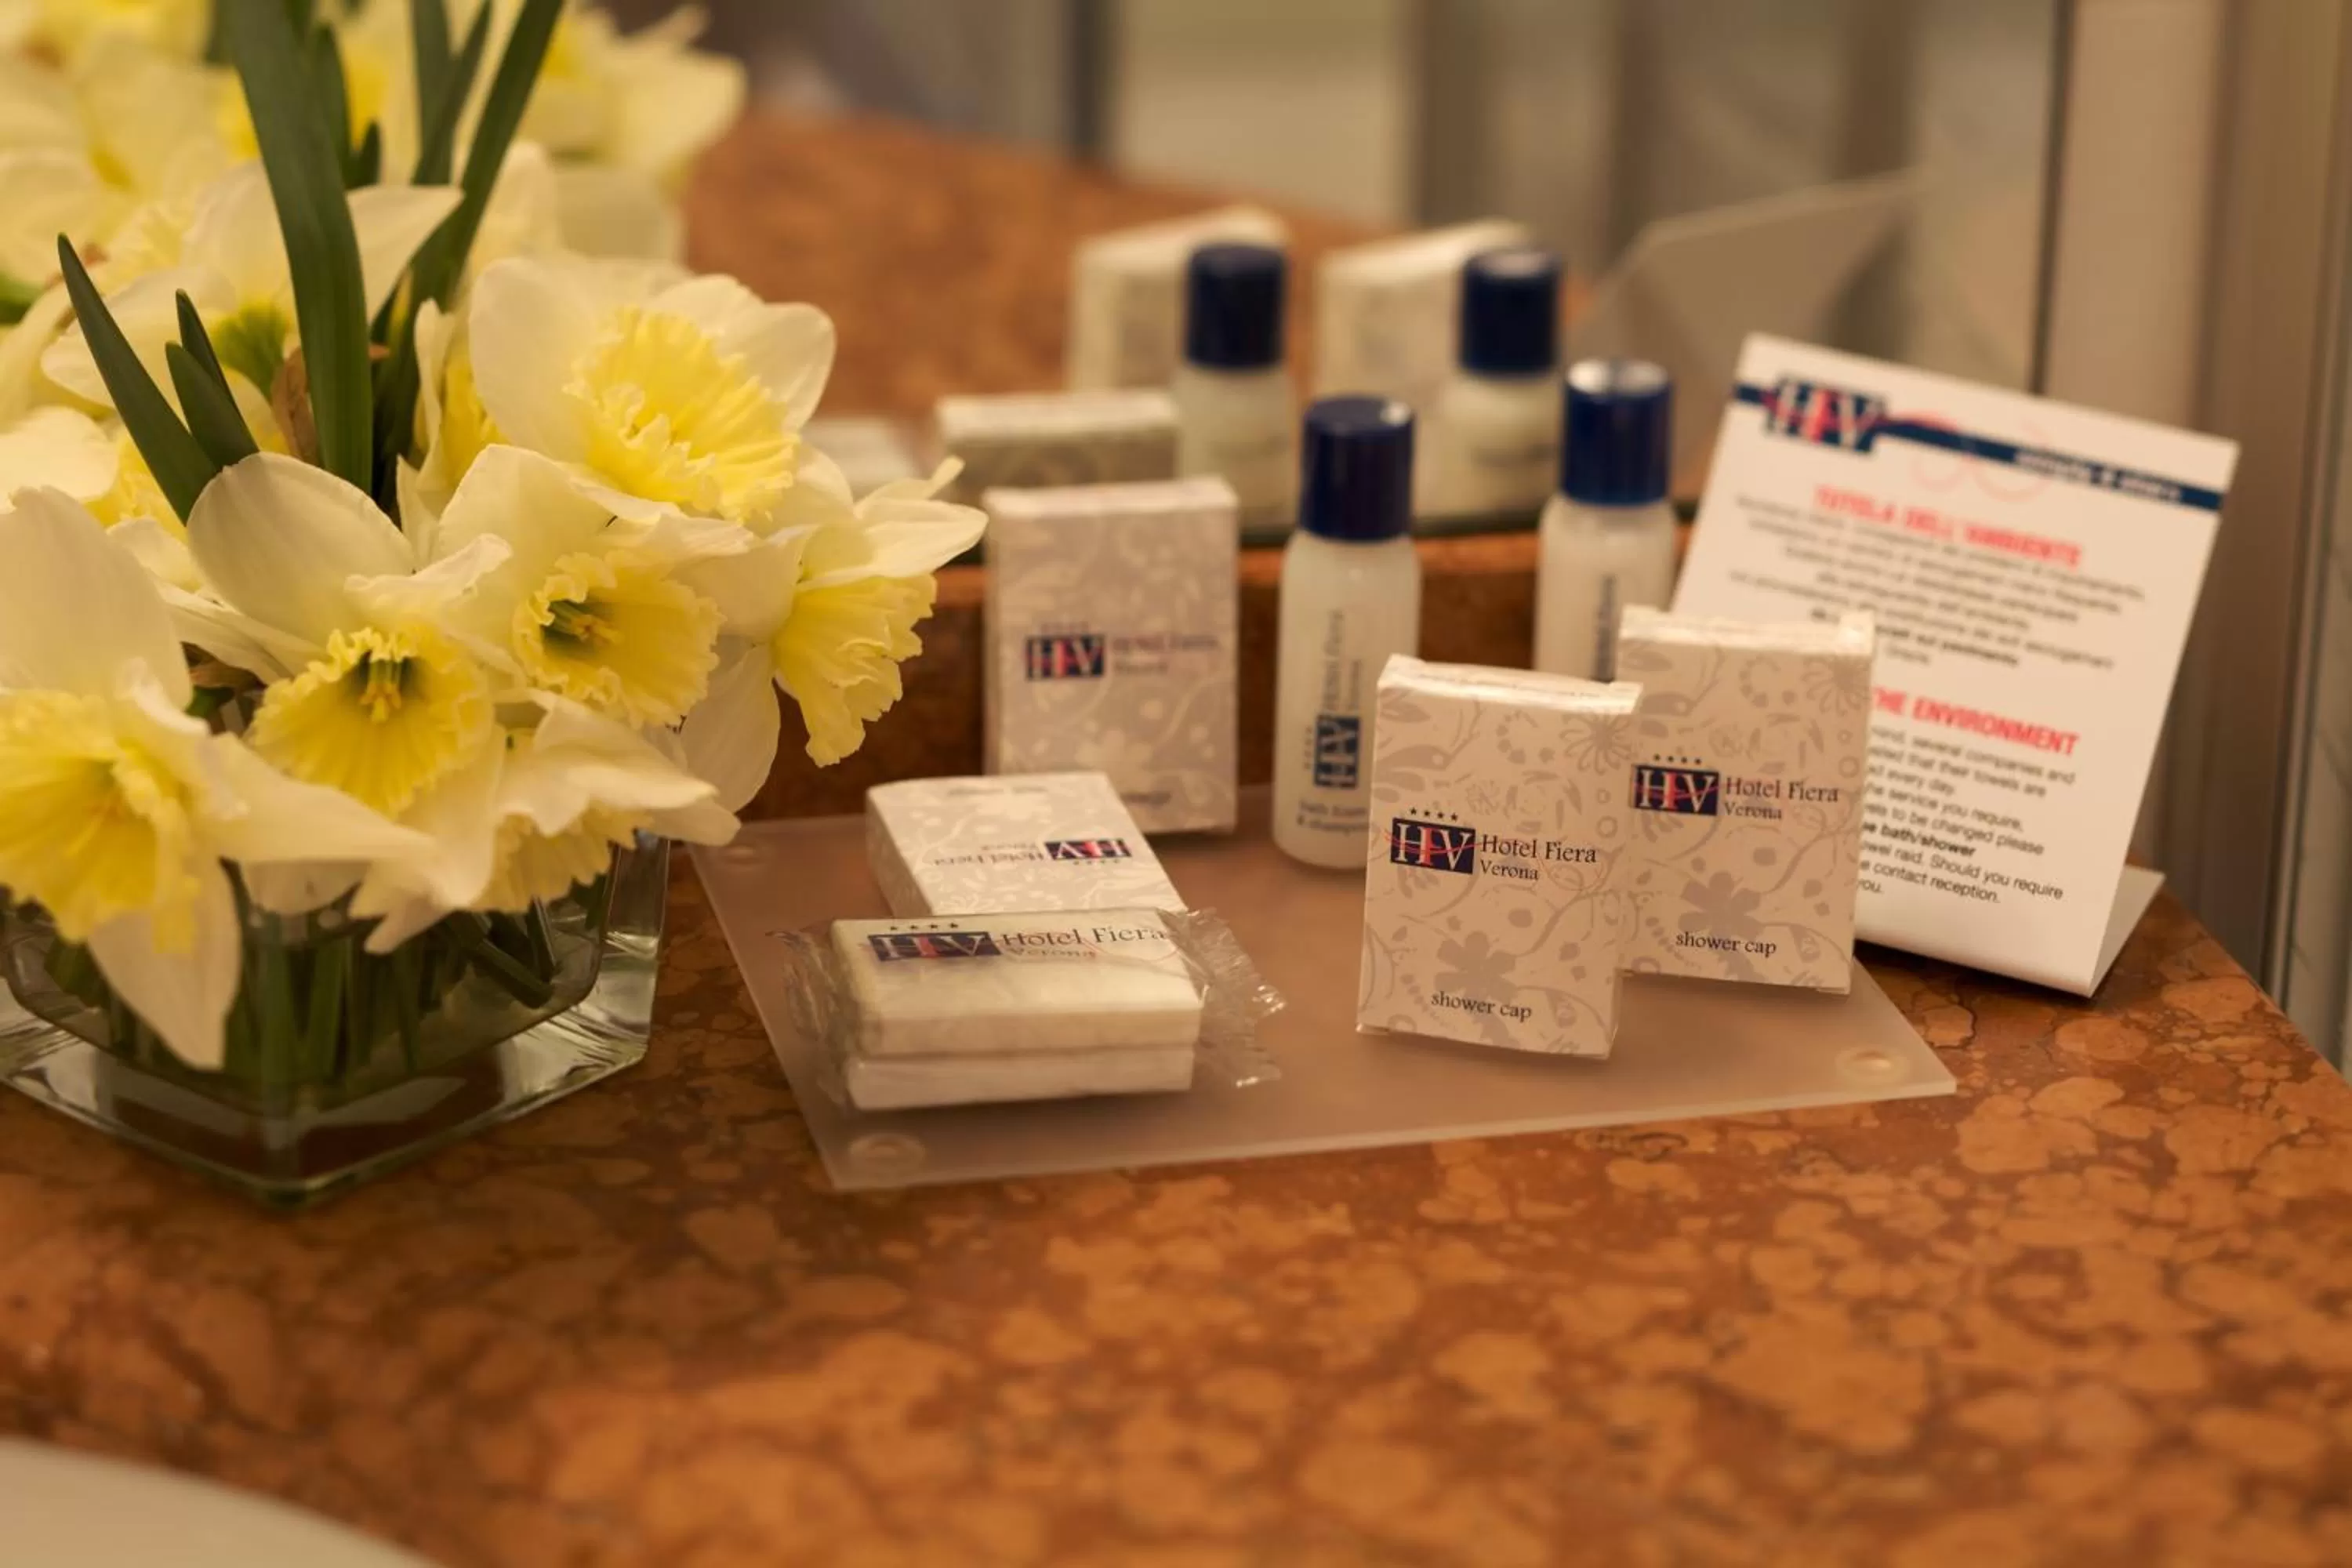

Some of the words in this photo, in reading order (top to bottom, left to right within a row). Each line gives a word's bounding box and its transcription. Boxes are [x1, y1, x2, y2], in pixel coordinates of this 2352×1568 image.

[1912, 697, 2080, 755] ENVIRONMENT
[1725, 777, 1780, 800] Hotel
[1788, 780, 1839, 803] Fiera
[1724, 801, 1782, 820] Verona
[1481, 833, 1538, 859] Hotel
[1544, 840, 1598, 864] Fiera
[1880, 823, 1976, 858] bath/shower
[1931, 818, 1994, 844] changed
[1995, 833, 2045, 856] please
[1481, 858, 1539, 881] Verona
[1872, 862, 1928, 885] contact
[1929, 877, 2002, 903] reception.
[1929, 852, 1982, 880] Should
[1984, 869, 2010, 887] you
[2013, 876, 2065, 901] require
[1000, 927, 1083, 946] Hotel
[1091, 924, 1167, 943] Fiera
[1675, 931, 1741, 953] shower
[1744, 939, 1777, 959] cap
[1430, 990, 1496, 1016] shower
[1500, 1003, 1533, 1023] cap
